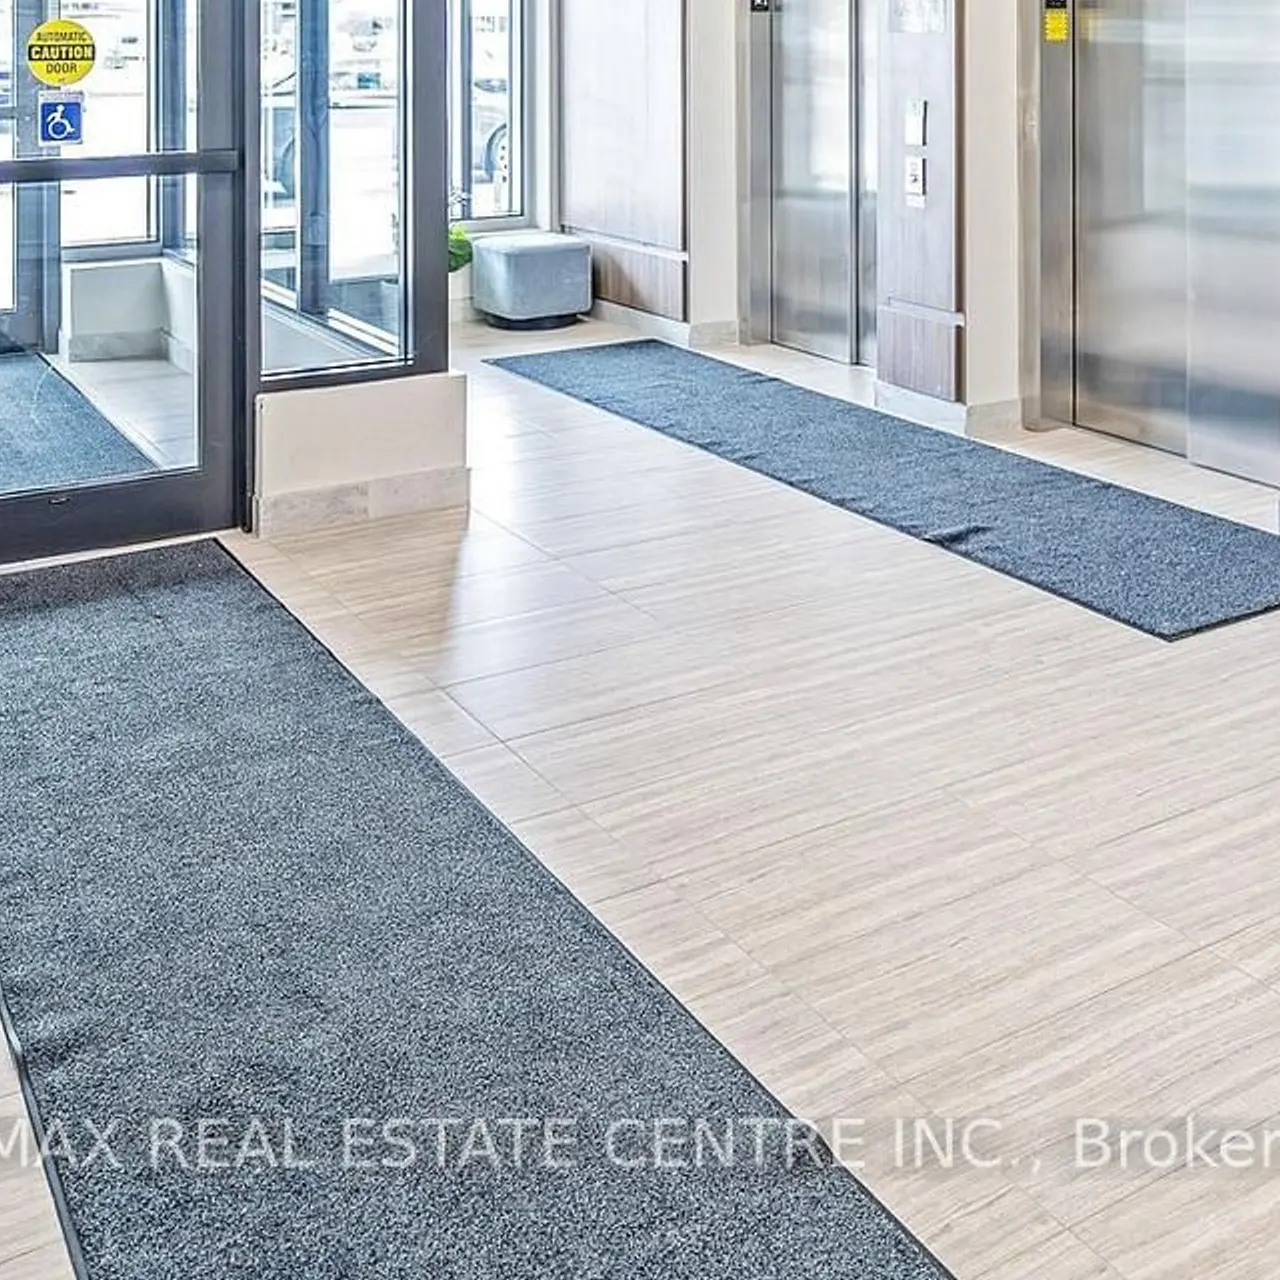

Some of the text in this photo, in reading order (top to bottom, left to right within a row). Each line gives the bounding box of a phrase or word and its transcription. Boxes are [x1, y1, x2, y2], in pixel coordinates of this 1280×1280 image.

[36, 31, 87, 43] AUTOMATIC
[30, 45, 93, 60] CAUTION
[46, 62, 78, 73] DOOR
